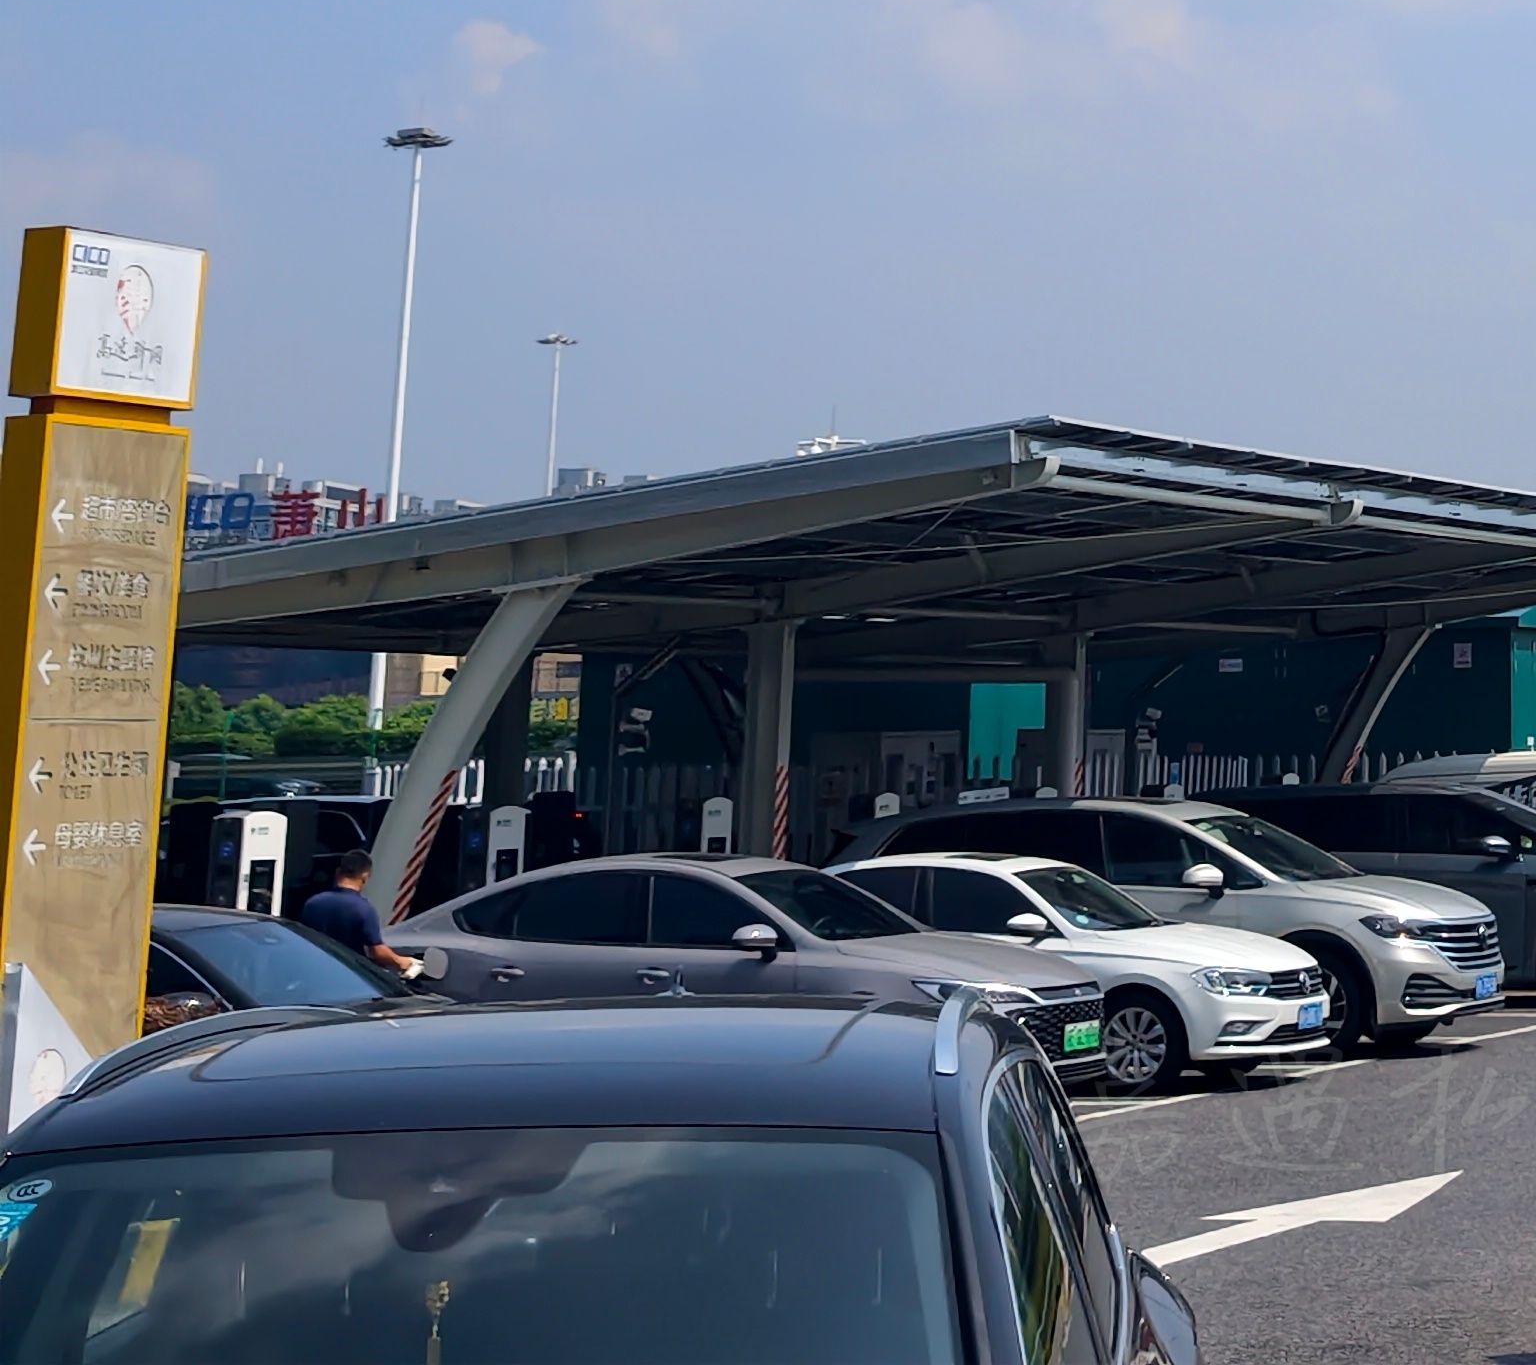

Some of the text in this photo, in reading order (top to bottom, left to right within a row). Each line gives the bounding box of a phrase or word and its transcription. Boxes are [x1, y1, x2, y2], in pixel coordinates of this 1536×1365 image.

[270, 469, 386, 541] 萧山
[55, 820, 143, 849] 母婴休息室
